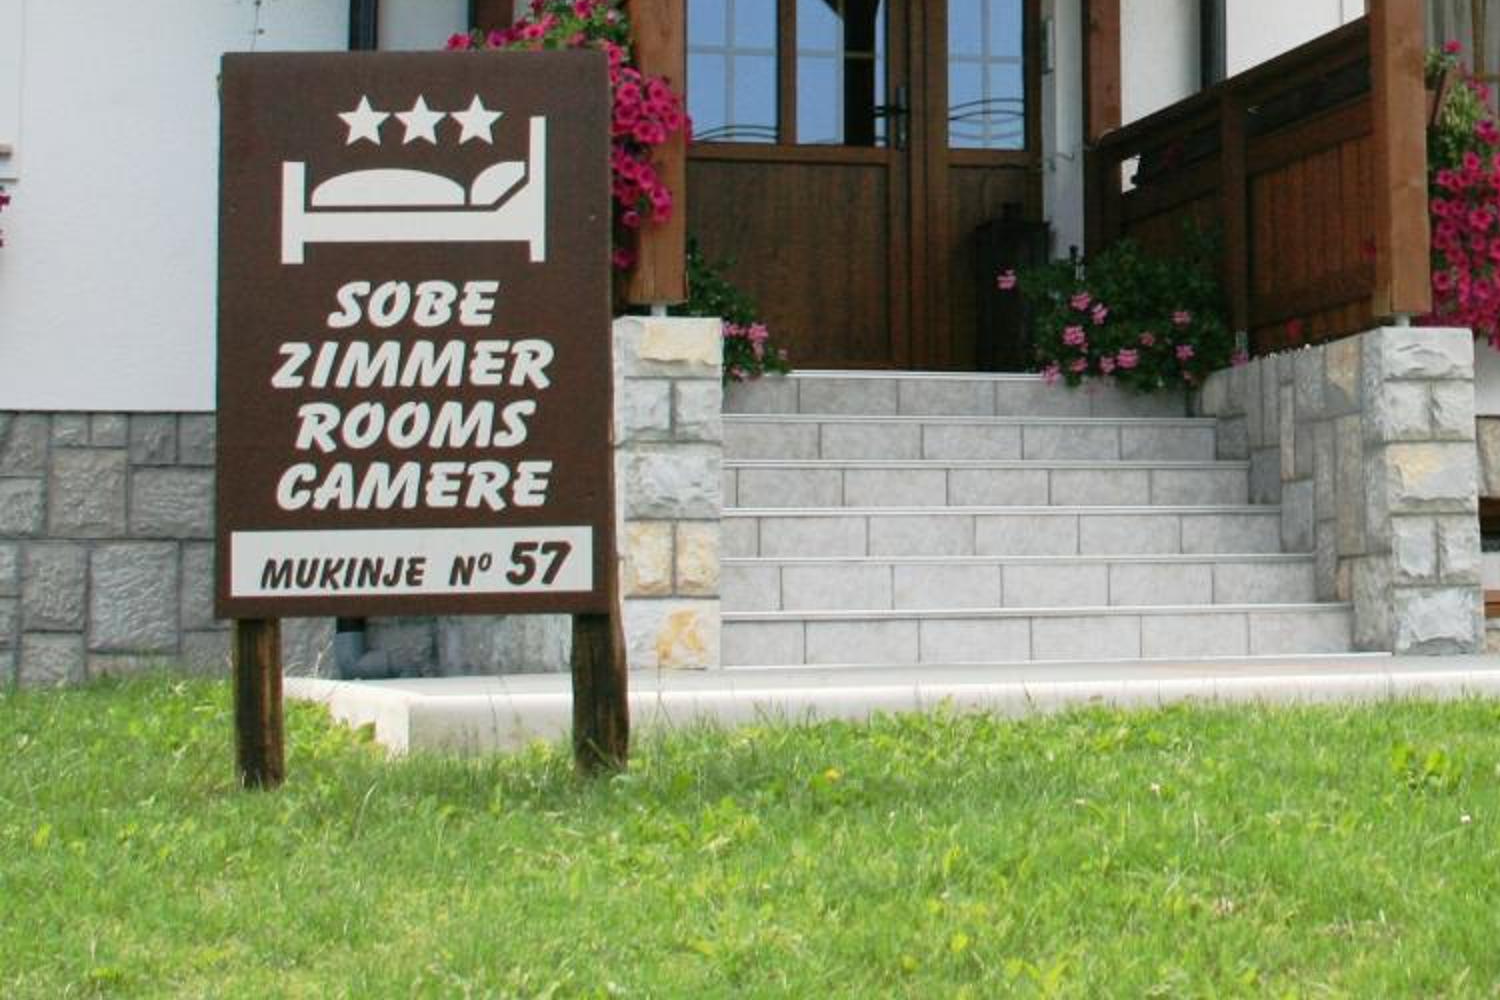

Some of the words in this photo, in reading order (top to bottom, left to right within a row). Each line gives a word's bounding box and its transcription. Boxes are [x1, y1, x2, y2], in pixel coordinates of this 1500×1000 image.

[328, 280, 499, 328] SOBE
[271, 339, 555, 390] ZIMMER
[295, 400, 536, 453] ROOMS
[276, 460, 553, 512] CAMERE
[260, 556, 426, 591] MUKINJE
[505, 540, 572, 586] 57
